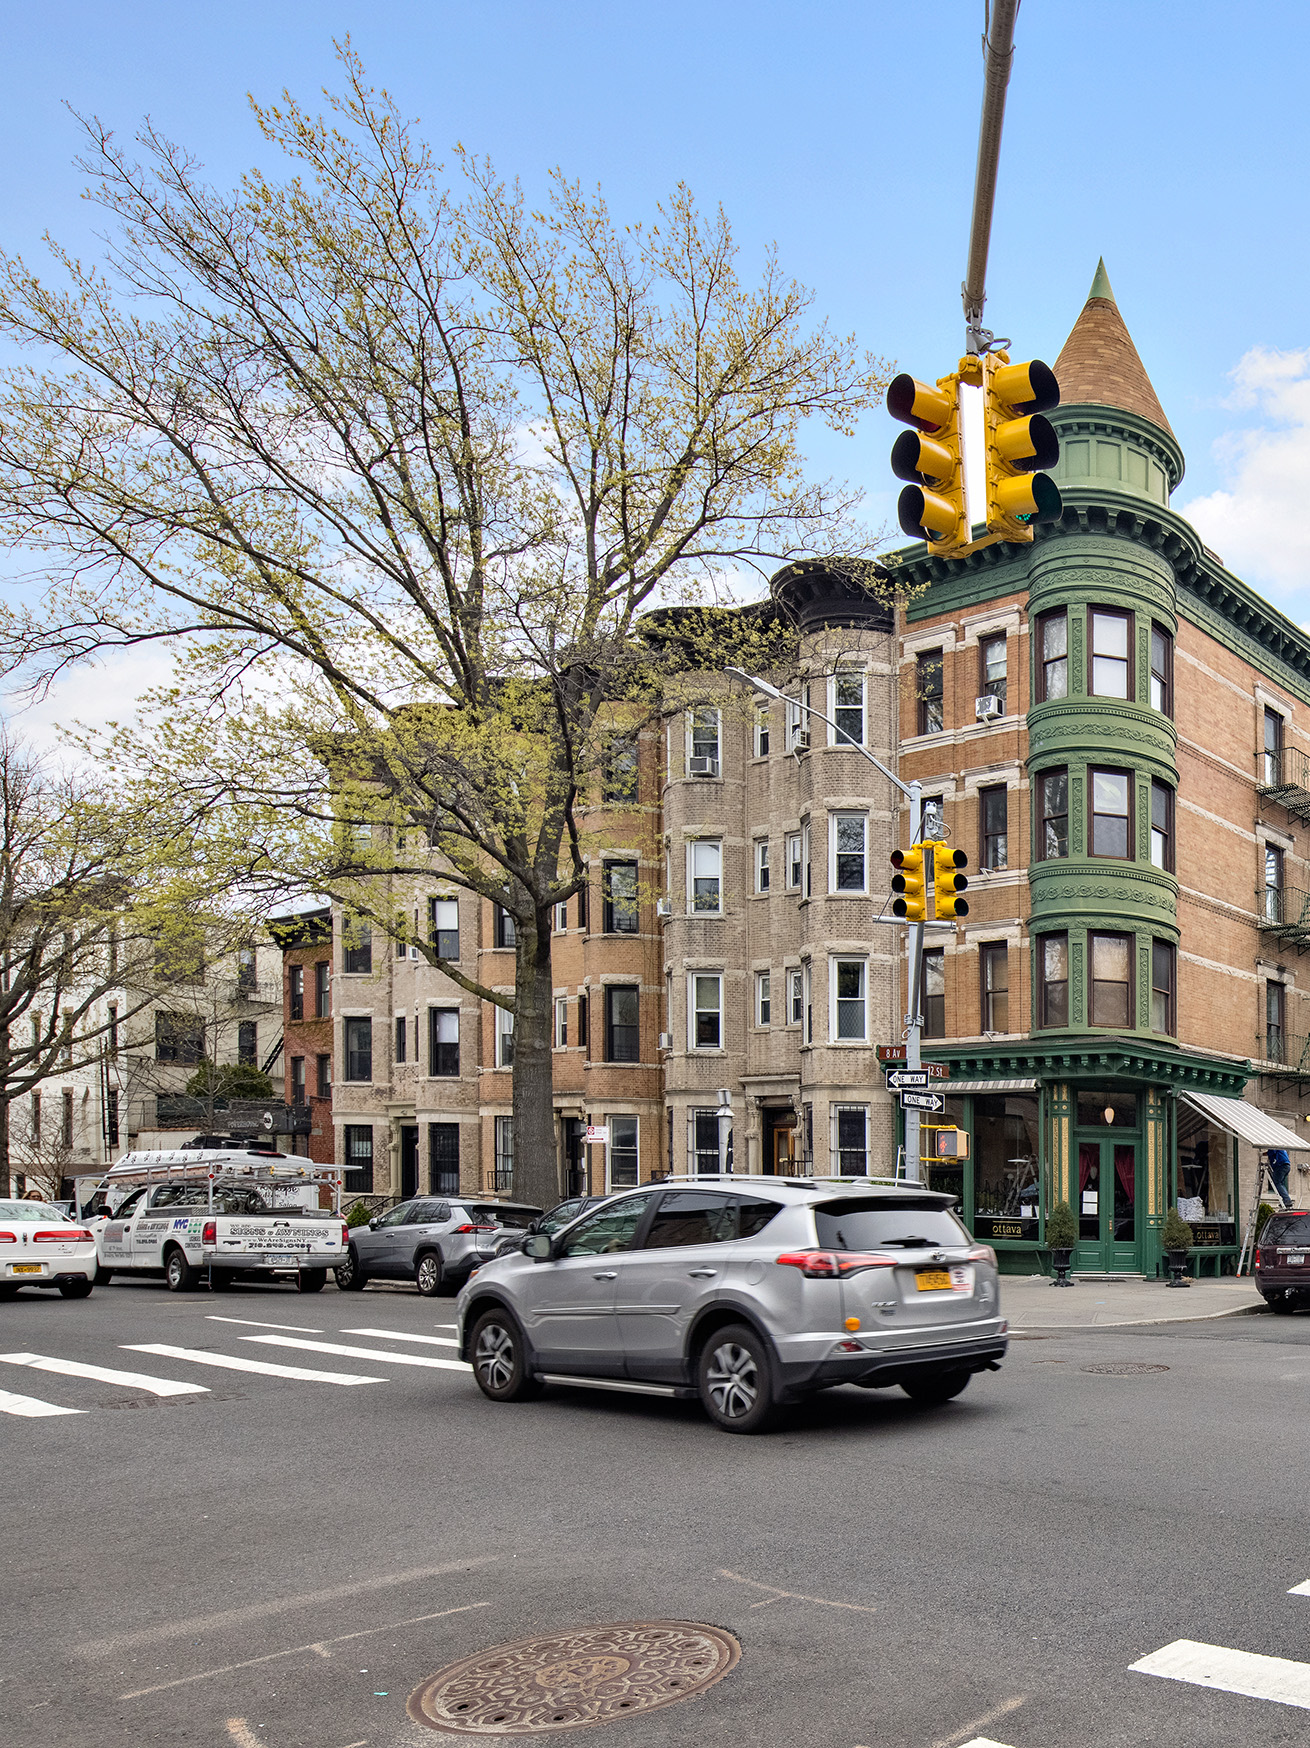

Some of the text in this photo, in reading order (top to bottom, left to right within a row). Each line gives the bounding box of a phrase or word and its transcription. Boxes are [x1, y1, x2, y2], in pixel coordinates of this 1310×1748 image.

[885, 1048, 901, 1058] 8 Av
[936, 1066, 943, 1077] St
[892, 1075, 924, 1083] ONE WAY
[907, 1095, 938, 1107] ONE WAY
[173, 1219, 189, 1229] NYC
[230, 1228, 266, 1236] SIGNS
[275, 1228, 329, 1238] AWNINGS
[992, 1225, 1022, 1234] ottava
